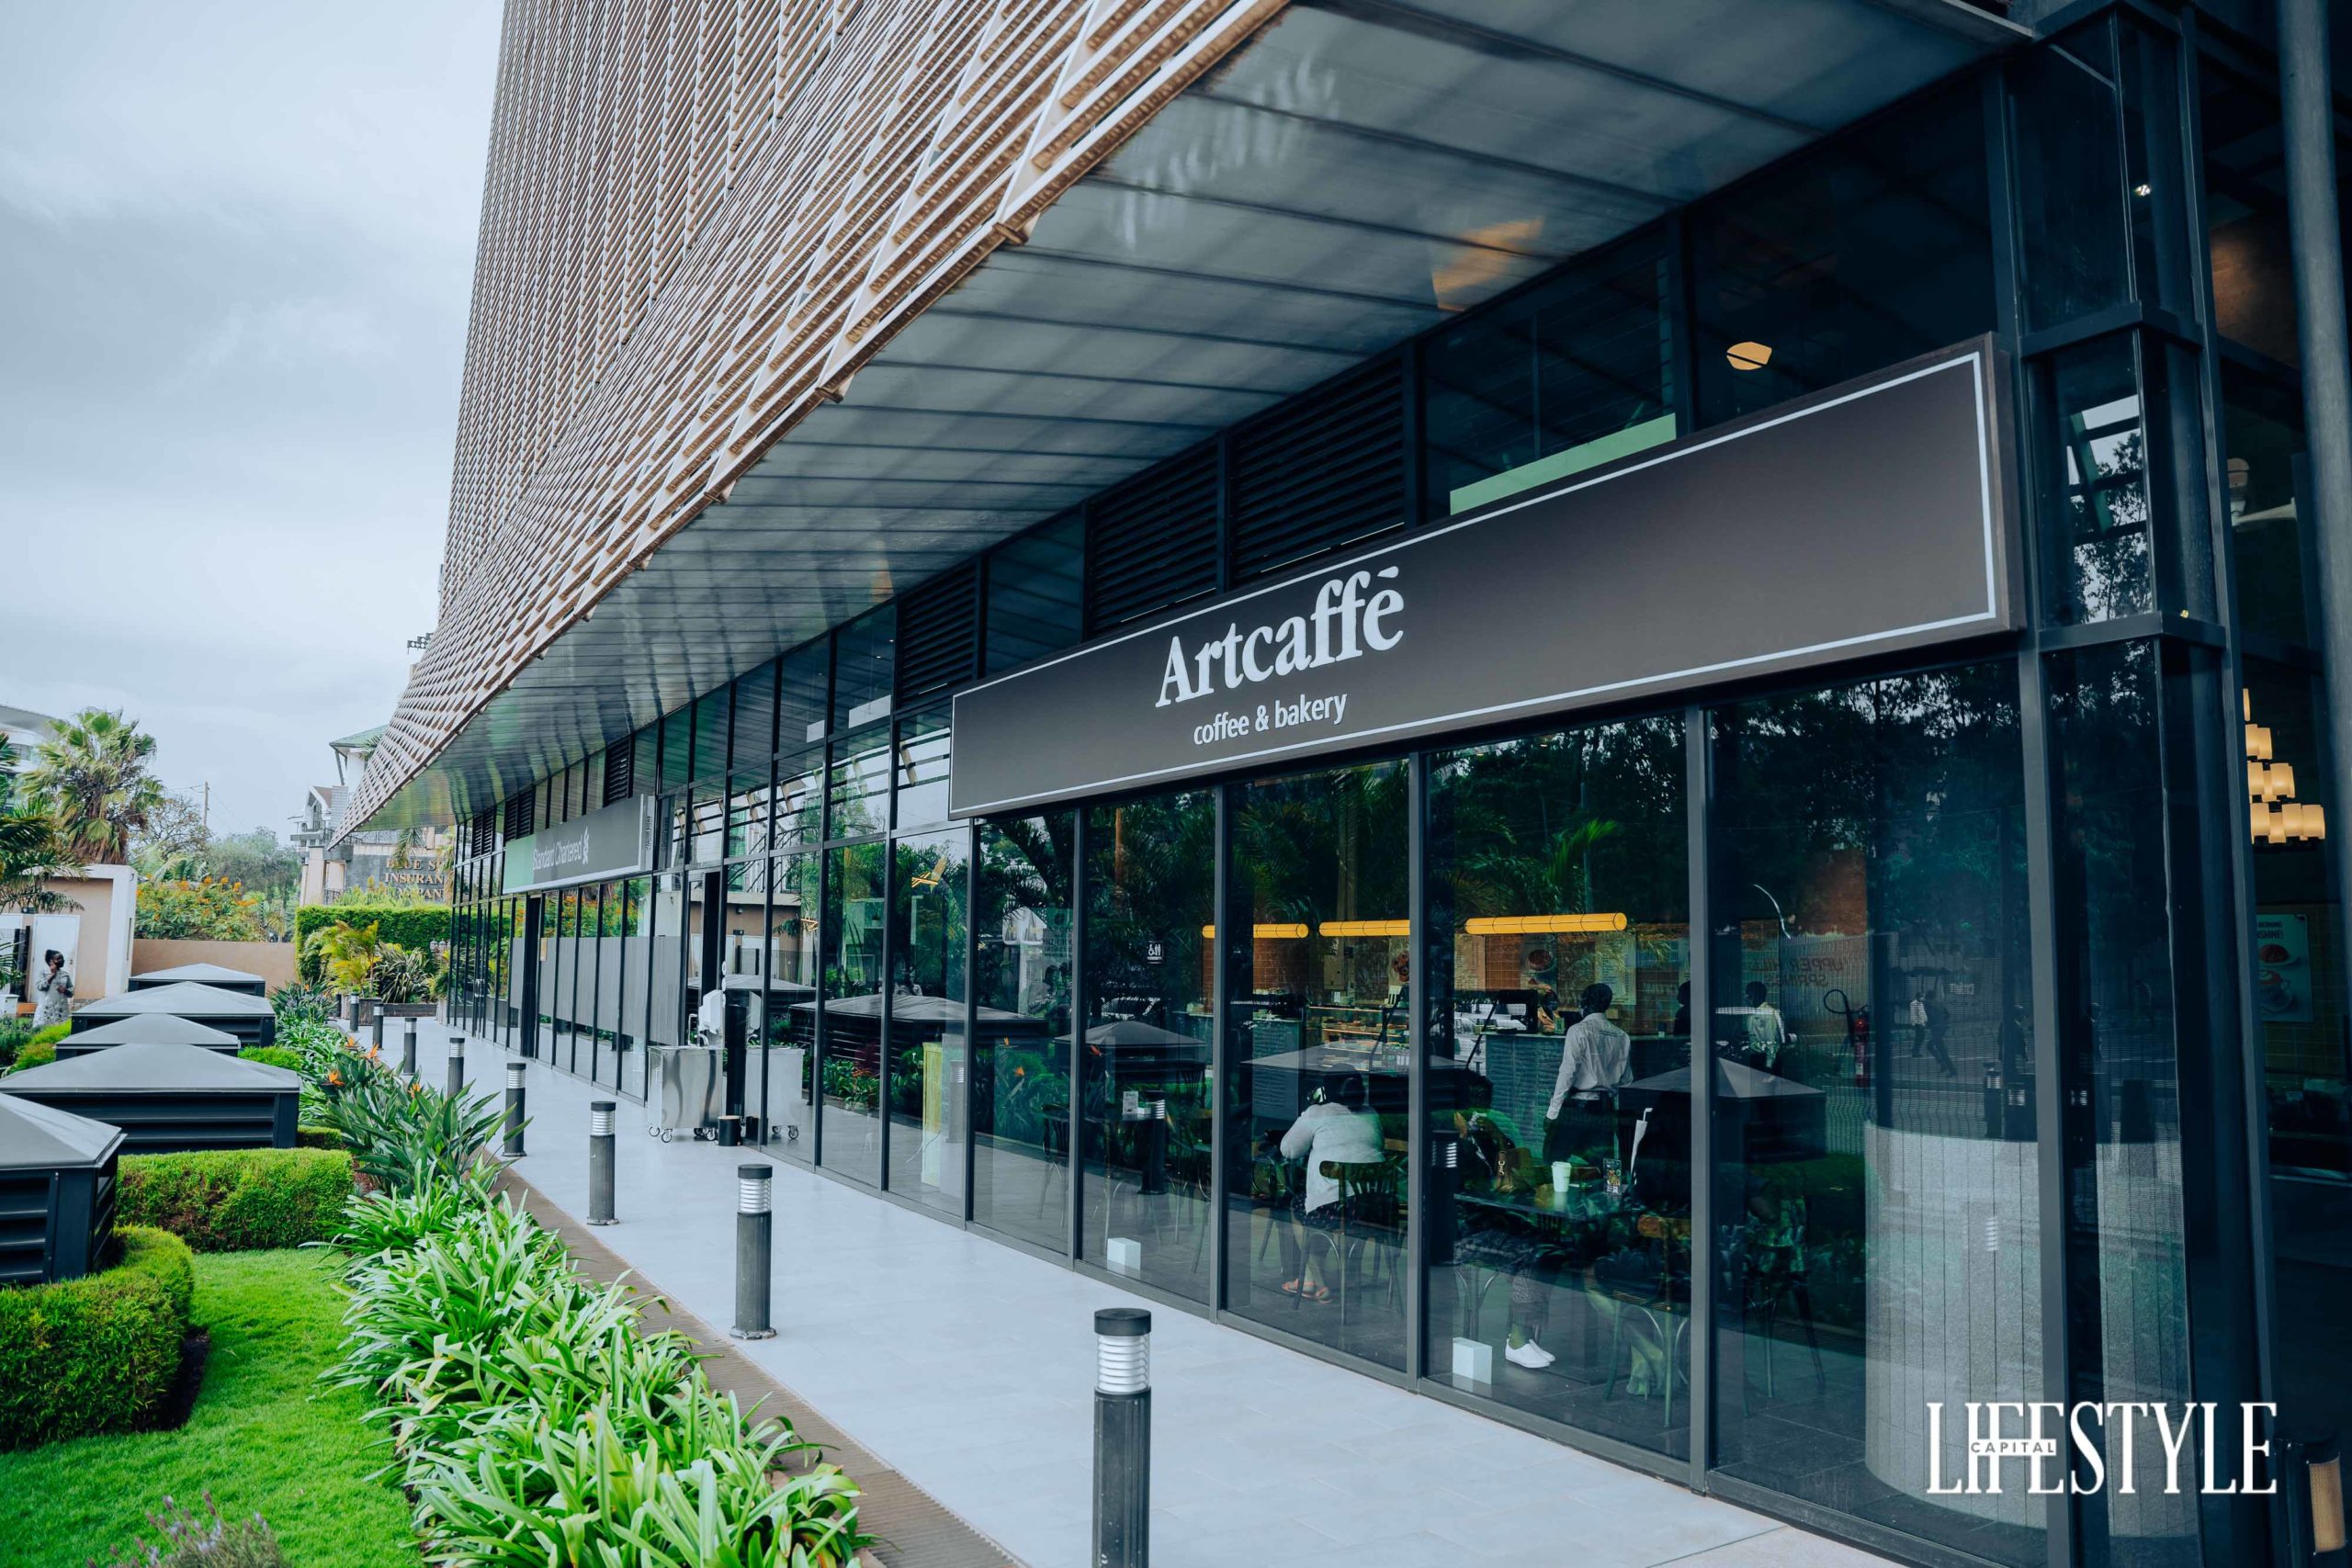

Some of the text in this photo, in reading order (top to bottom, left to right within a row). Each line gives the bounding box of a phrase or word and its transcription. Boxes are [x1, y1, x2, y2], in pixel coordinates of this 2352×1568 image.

[1155, 566, 1405, 708] Artcaffé
[1193, 694, 1348, 746] coffee & bakery
[533, 834, 582, 871] Standard Chartered
[384, 872, 444, 885] INSURAN
